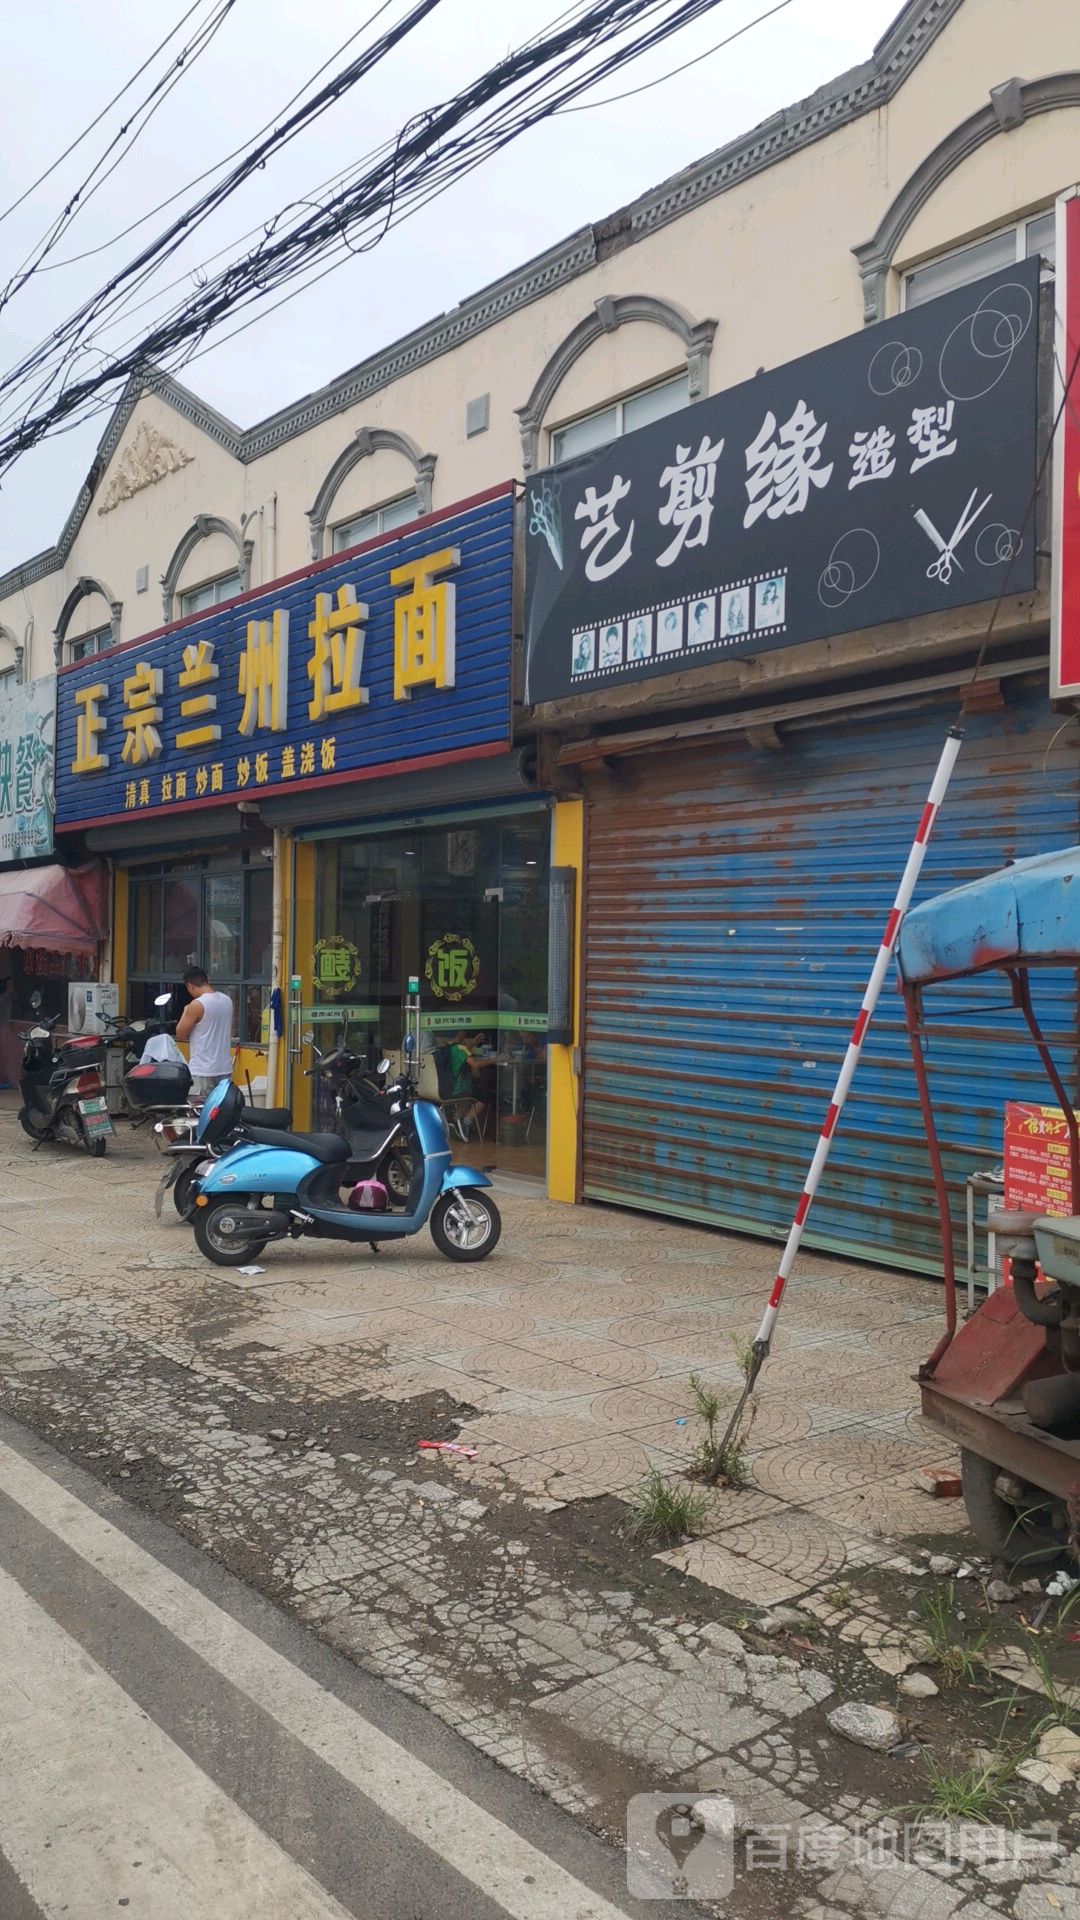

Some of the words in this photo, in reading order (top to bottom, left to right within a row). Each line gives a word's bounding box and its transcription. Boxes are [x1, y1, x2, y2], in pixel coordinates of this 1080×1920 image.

[72, 547, 461, 774] 正宗兰州拉面
[125, 778, 150, 808] 清真
[161, 771, 187, 801] 拉面
[195, 763, 224, 795] 炒面
[237, 752, 269, 786] 炒饭
[281, 736, 336, 778] 盖浇饭
[437, 948, 469, 988] 饭
